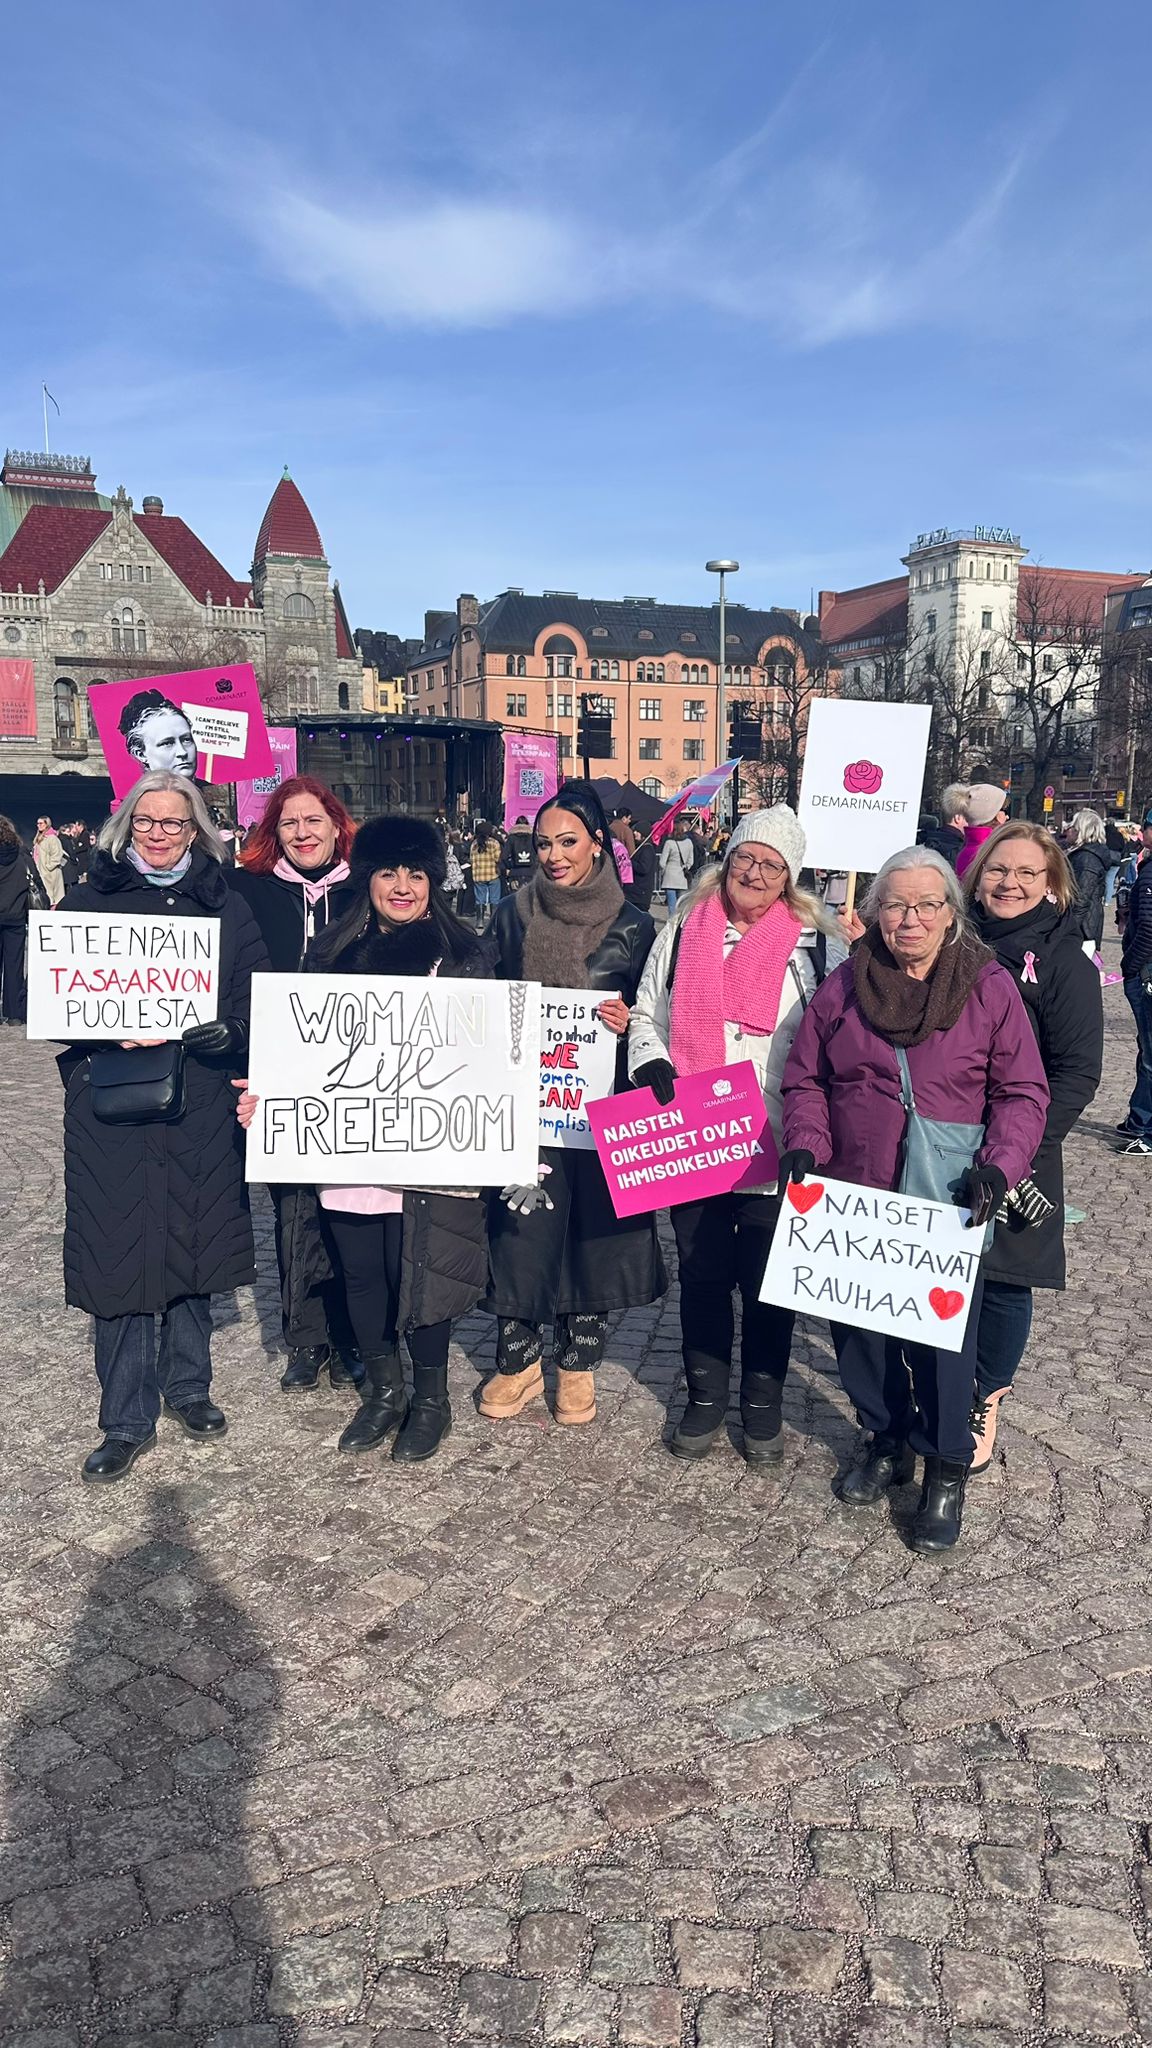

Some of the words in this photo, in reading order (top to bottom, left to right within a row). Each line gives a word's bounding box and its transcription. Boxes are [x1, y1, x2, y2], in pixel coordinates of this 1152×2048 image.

[917, 526, 949, 547] PLAZA
[975, 525, 1014, 543] PLAZA
[192, 729, 227, 739] PROTESTING
[228, 734, 240, 742] THIS
[216, 719, 239, 728] BELIEVE
[811, 794, 908, 813] DEMARINAISET
[38, 923, 211, 960] ETEENPÄIN
[49, 967, 212, 995] TASA-ARVON
[66, 997, 201, 1029] PUOLESTA
[289, 990, 487, 1047] WOMAN
[573, 1003, 586, 1020] is
[546, 1028, 563, 1042] to
[565, 1025, 598, 1044] what
[322, 1021, 469, 1120] Life
[540, 1072, 590, 1088] omen.
[702, 1091, 748, 1109] DEMARINAISET
[263, 1094, 515, 1155] FREEDOM
[602, 1109, 685, 1144] NAISTEN
[610, 1129, 699, 1167] OIKEUDET
[701, 1115, 753, 1143] OVAT
[616, 1139, 765, 1190] IHMISOIKEUKSIA
[825, 1193, 943, 1233] NAISET
[787, 1215, 981, 1283] RAKASTAVAT
[792, 1265, 923, 1321] RAUHAA
